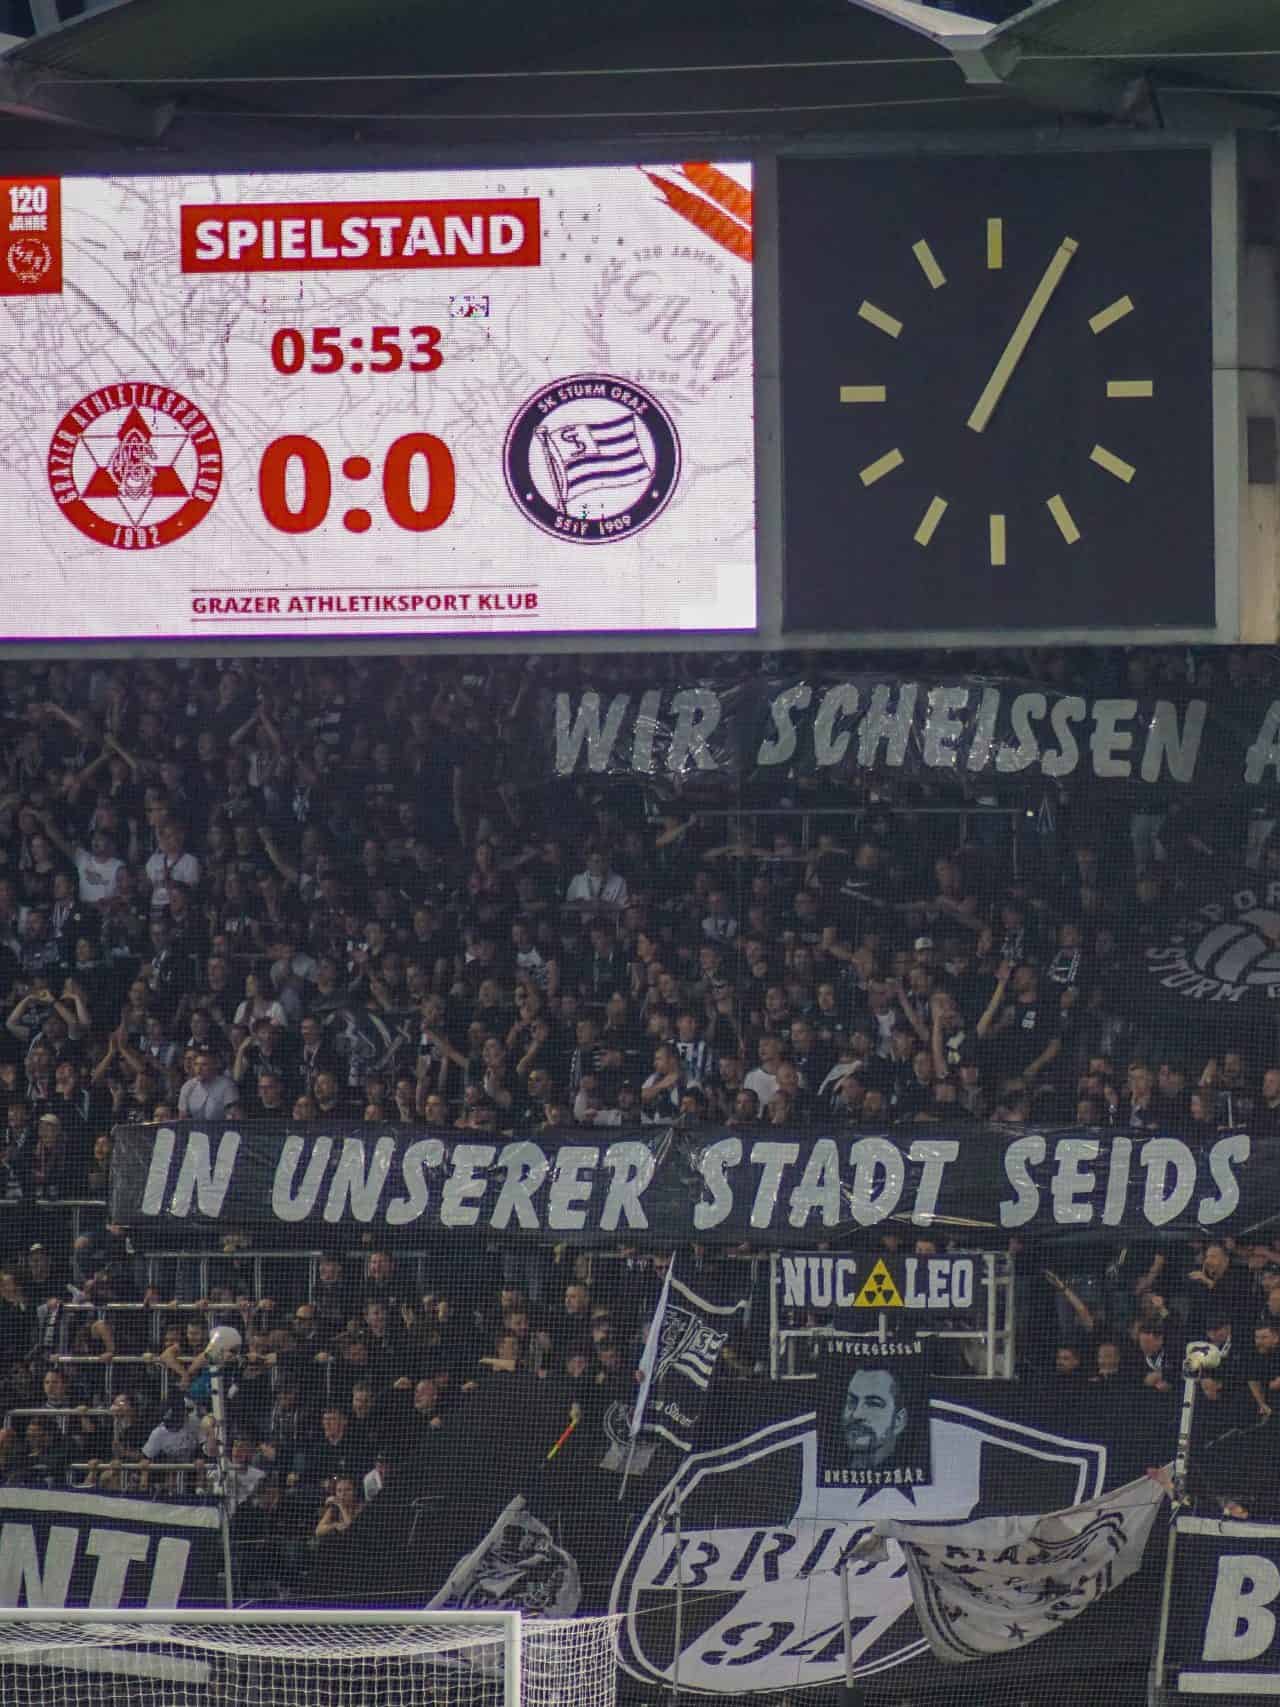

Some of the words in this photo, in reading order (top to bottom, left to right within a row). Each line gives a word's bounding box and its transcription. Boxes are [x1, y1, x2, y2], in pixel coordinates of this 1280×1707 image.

[8, 185, 48, 213] 120
[8, 214, 48, 231] JAHRE
[195, 214, 525, 260] SPIELSTAND
[271, 325, 444, 375] 05:53
[537, 395, 557, 413] SK
[558, 384, 607, 400] STURM
[611, 386, 649, 414] GRAZ
[258, 432, 456, 535] 0:0
[599, 515, 632, 535] 1909
[191, 597, 281, 614] GRAZER
[287, 594, 471, 613] ATHLETIKSPORT
[478, 592, 539, 611] KLUB
[551, 686, 723, 776] WIR
[757, 682, 1206, 783] SCHEISSEN
[1146, 946, 1249, 1002] STURM
[141, 1128, 241, 1218] IN
[271, 1135, 656, 1231] UNSERER
[693, 1136, 960, 1229] STADT
[1001, 1135, 1250, 1229] SEIDS
[701, 1615, 877, 1666] 94
